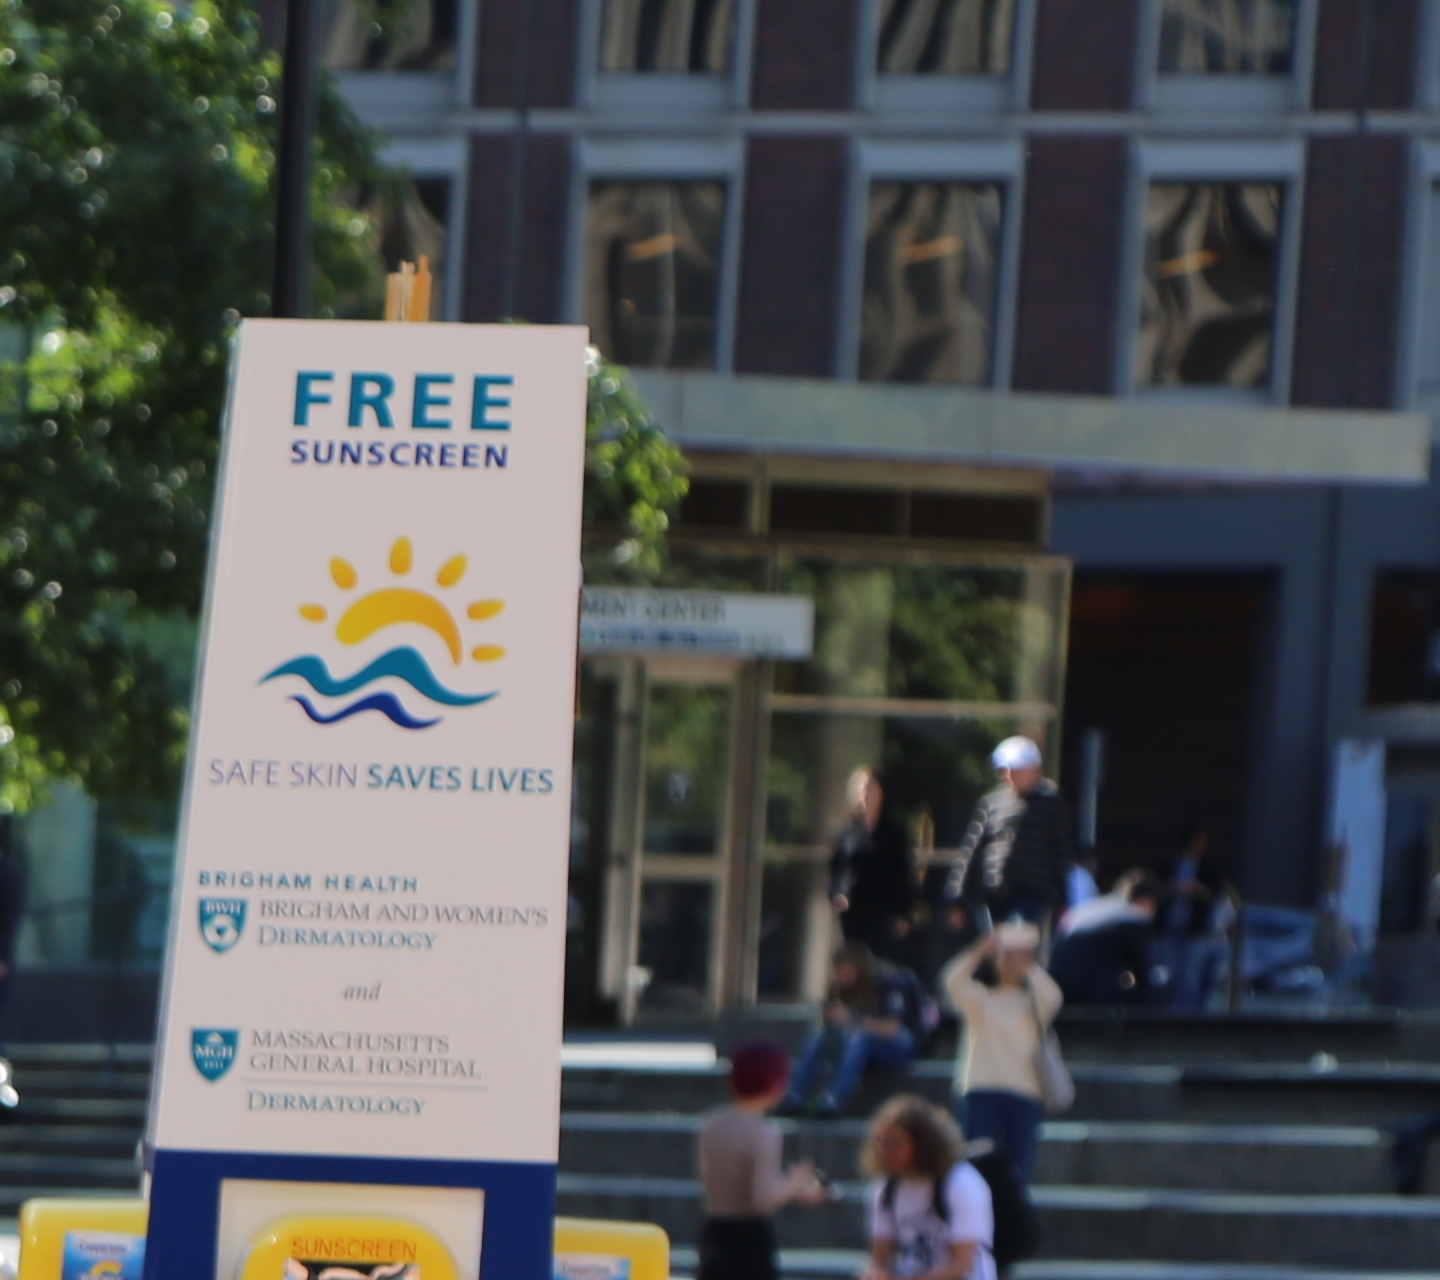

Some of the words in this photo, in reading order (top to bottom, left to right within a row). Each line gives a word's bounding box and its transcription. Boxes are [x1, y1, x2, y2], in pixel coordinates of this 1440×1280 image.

[293, 370, 514, 431] FREE
[291, 440, 509, 469] SUNSCREEN
[209, 758, 280, 786] SAFE
[290, 761, 357, 787] SKIN
[368, 764, 461, 790] SAVES
[472, 767, 553, 792] LIVES
[199, 871, 312, 890] BRIGHAM
[325, 874, 418, 893] HEALTH
[260, 900, 370, 921] BRIGHAM
[378, 904, 429, 922] AND
[436, 905, 548, 926] WOMEN'S
[343, 982, 381, 1001] and
[253, 1029, 449, 1053] MASSACHUSETTS
[250, 1053, 360, 1074] GENERAL
[368, 1056, 480, 1078] HOSPITAL
[291, 1237, 417, 1260] SUNSCREEN
